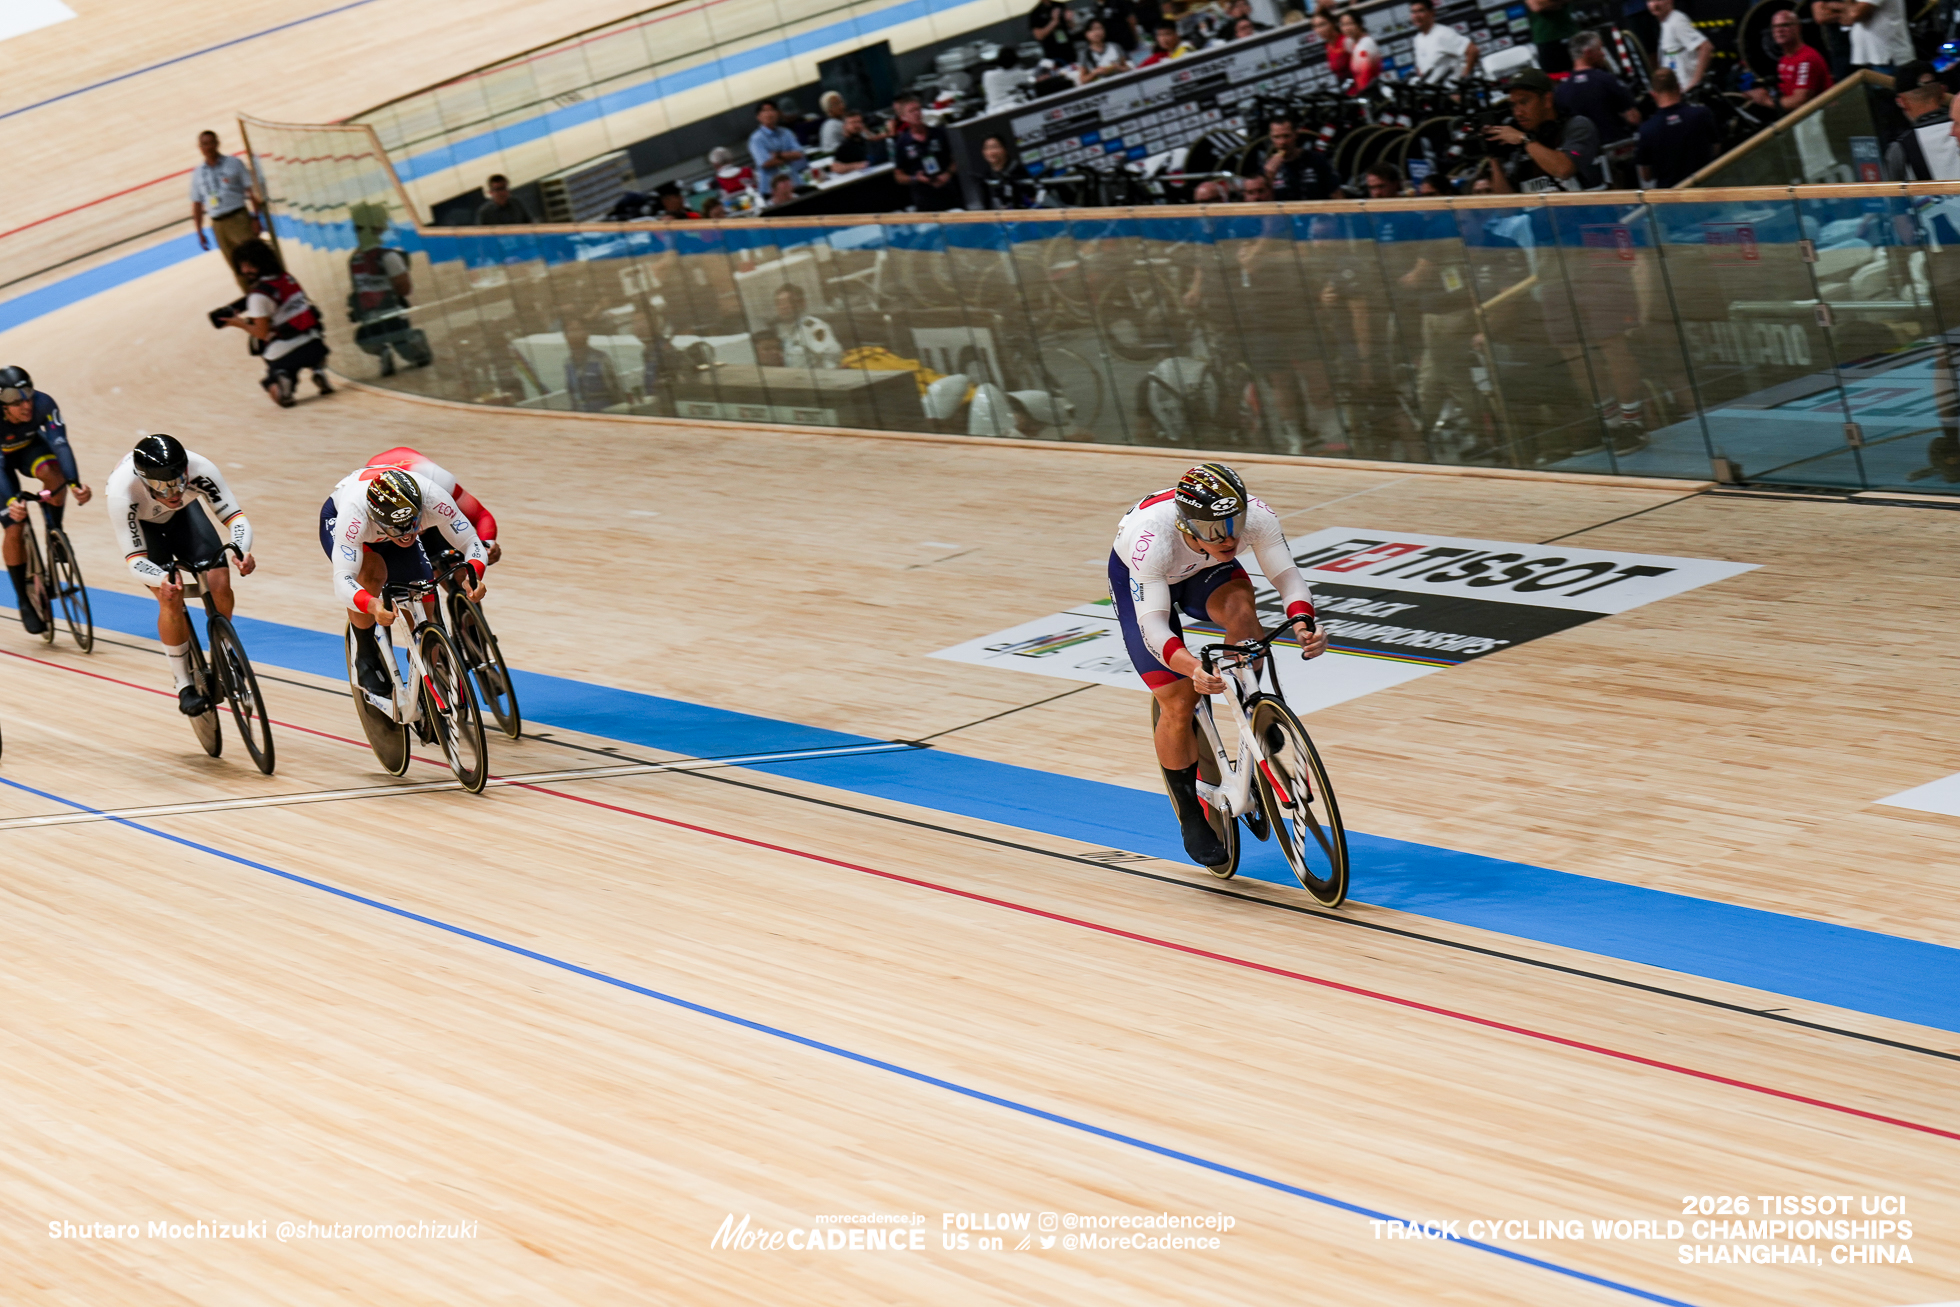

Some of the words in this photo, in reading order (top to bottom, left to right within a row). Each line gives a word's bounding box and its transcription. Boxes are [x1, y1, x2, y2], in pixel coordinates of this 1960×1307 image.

[189, 475, 222, 503] KTM
[127, 502, 142, 547] SKODA
[415, 534, 433, 569] JAPA
[1369, 546, 1679, 597] TISSOT
[1320, 597, 1420, 618] TRACK
